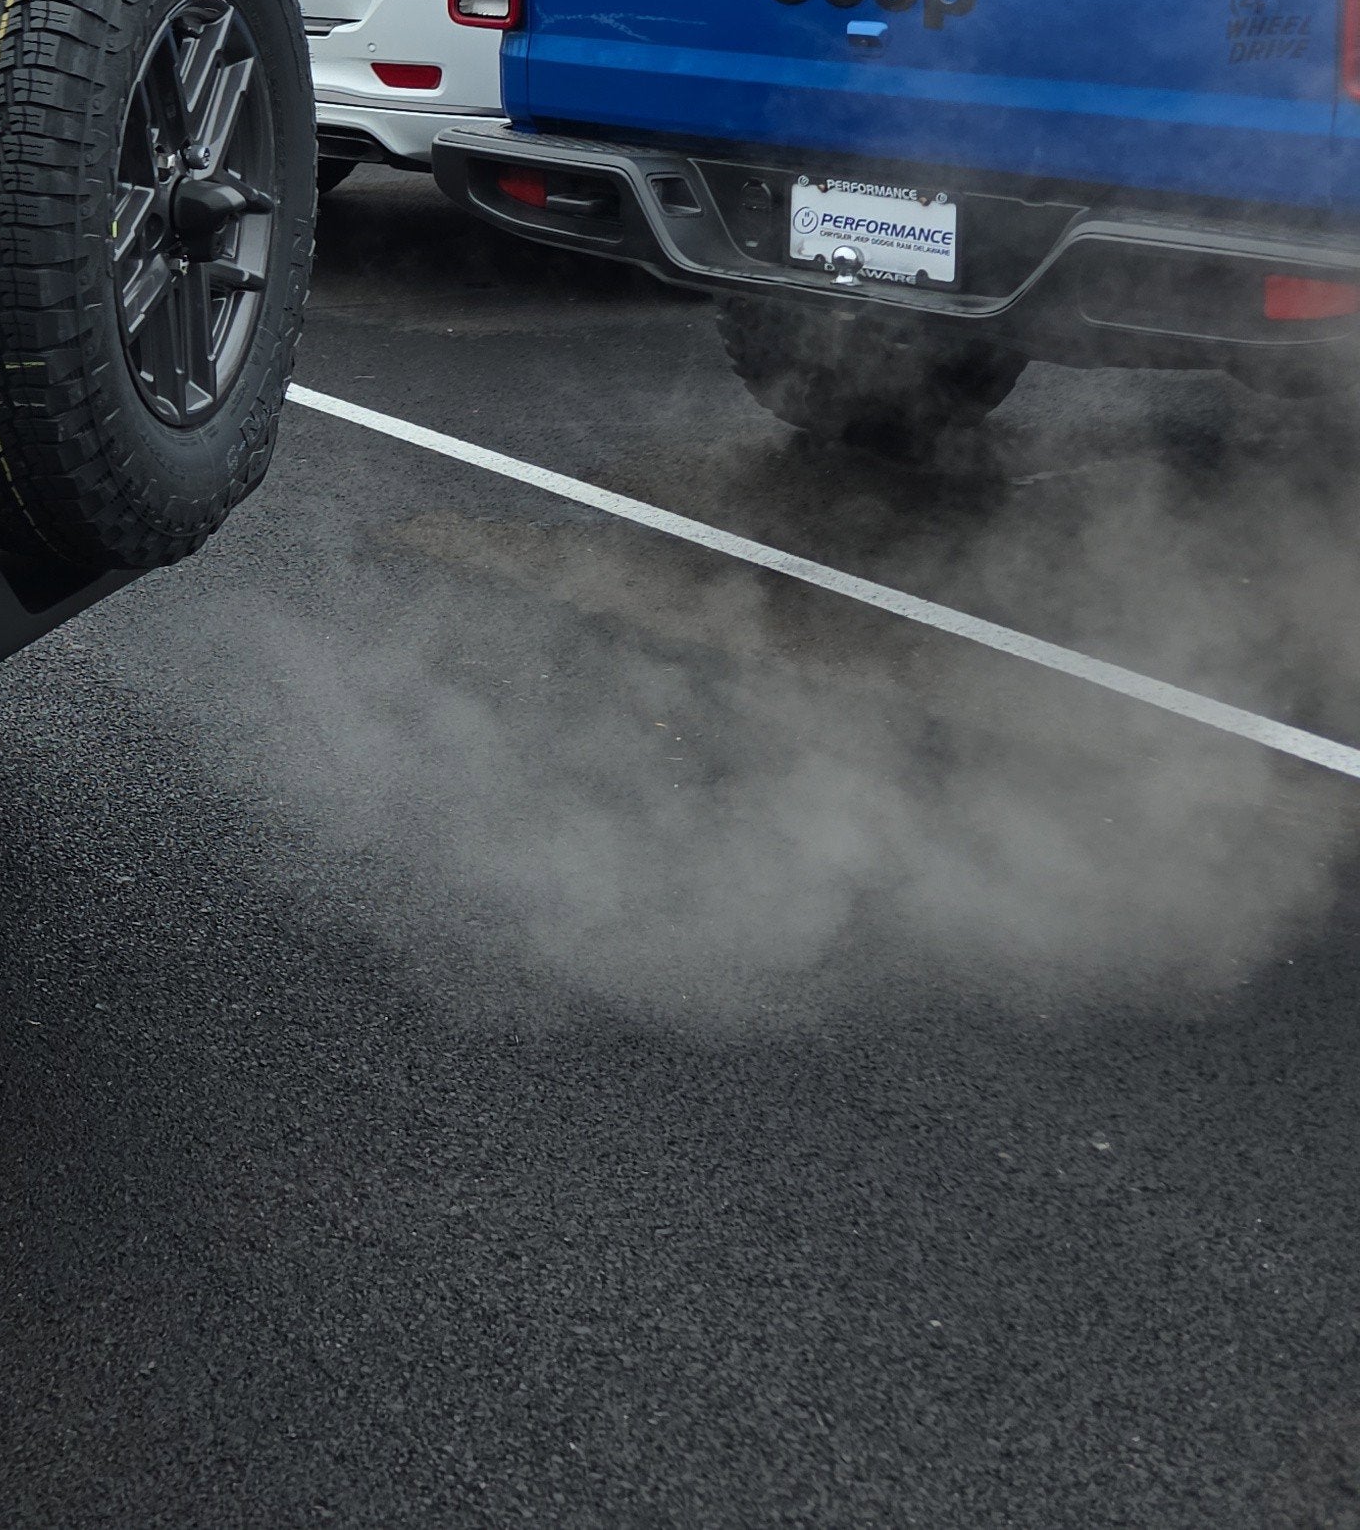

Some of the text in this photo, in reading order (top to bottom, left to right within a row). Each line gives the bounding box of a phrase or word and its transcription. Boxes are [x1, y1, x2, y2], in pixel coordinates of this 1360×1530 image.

[1227, 15, 1312, 39] WHEEL
[1229, 38, 1311, 63] DRIVE
[827, 179, 917, 201] PERFORMANCE
[821, 213, 953, 245] PERFORMANCE
[820, 230, 852, 241] CHRYSLER
[871, 238, 894, 247] DODGE
[896, 241, 912, 250] RAM
[913, 244, 950, 256] DELAWARE
